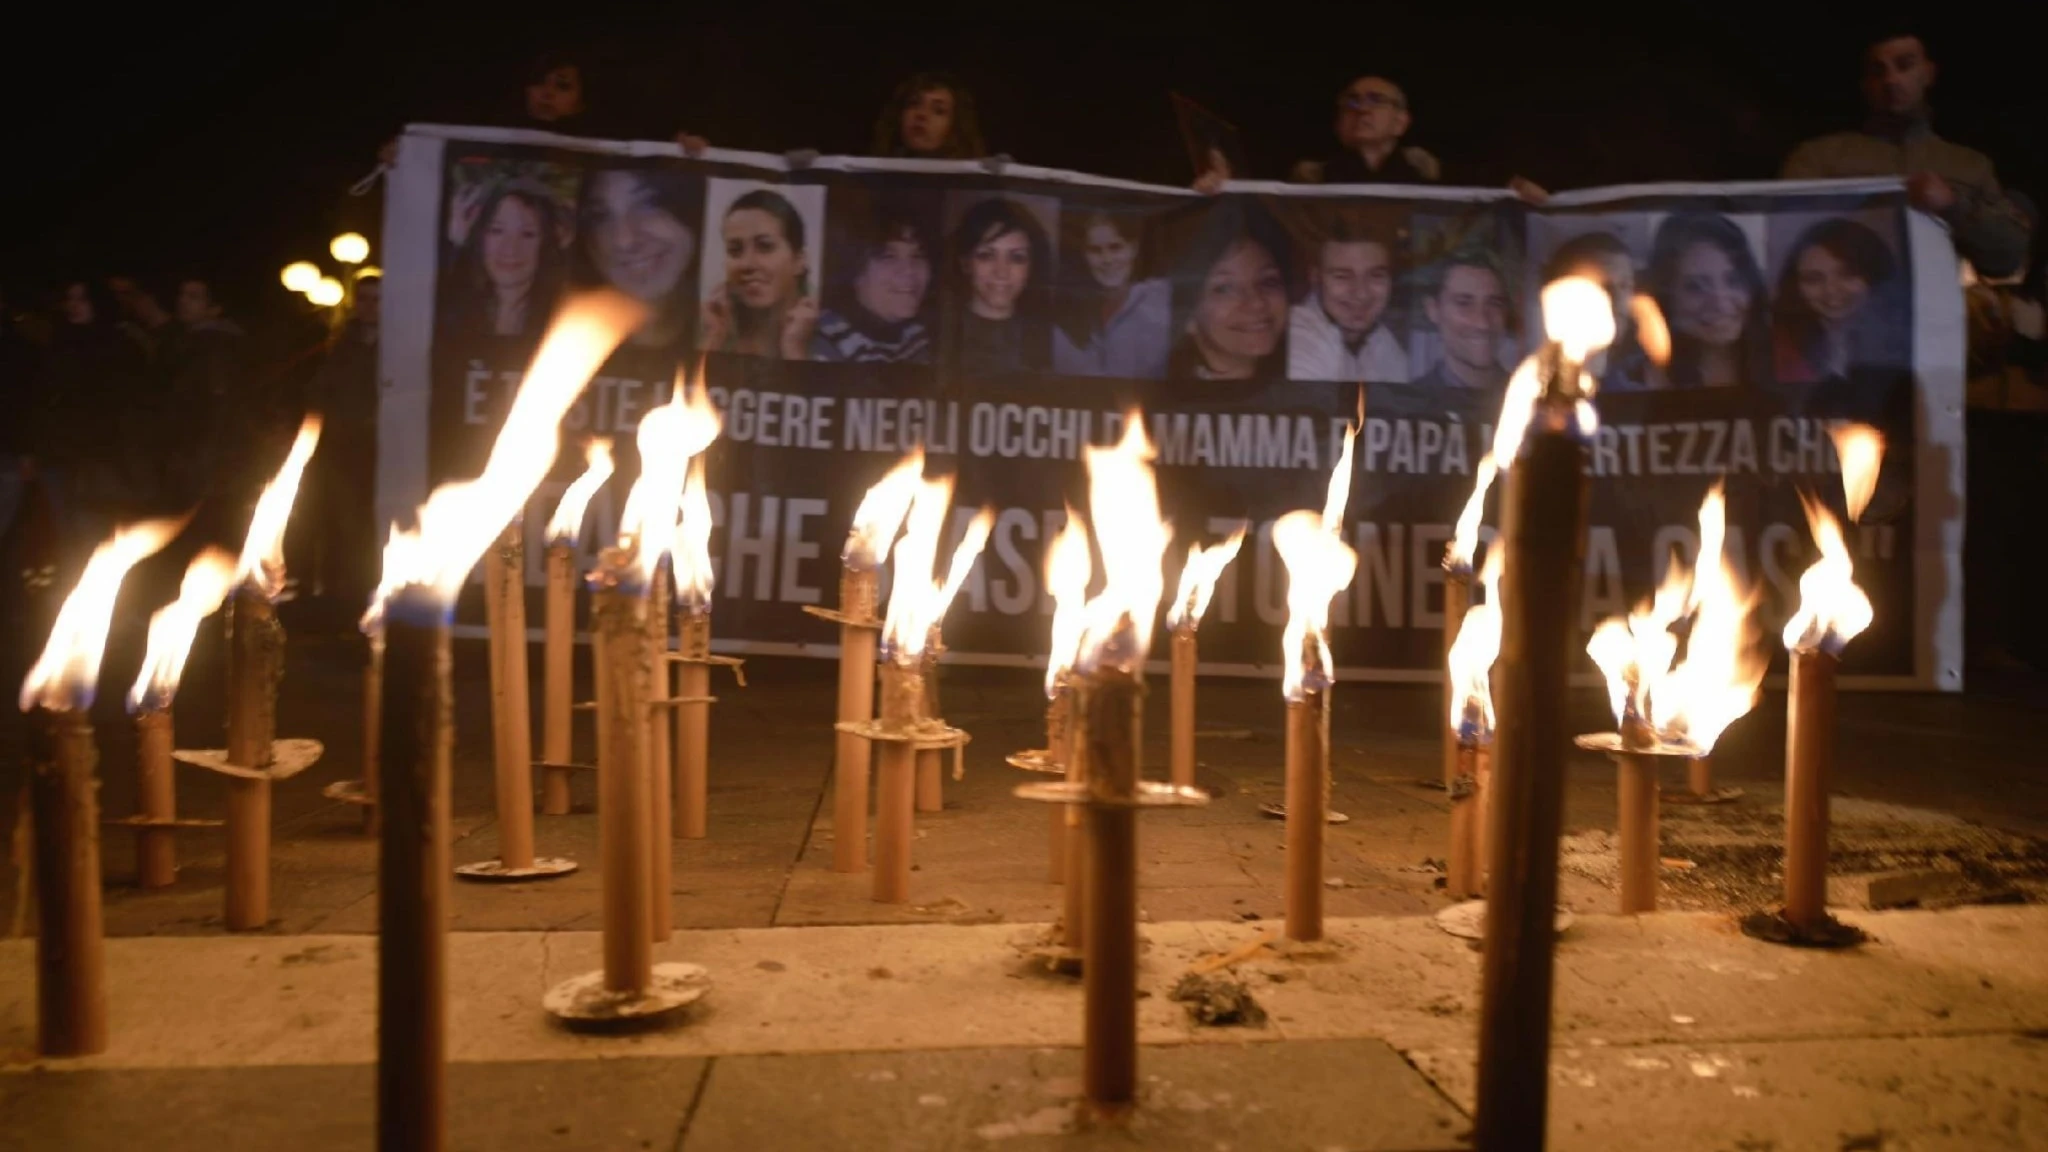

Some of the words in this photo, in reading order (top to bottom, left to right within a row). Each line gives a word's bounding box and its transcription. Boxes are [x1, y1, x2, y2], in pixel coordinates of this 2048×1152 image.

[463, 359, 492, 425] È
[844, 398, 958, 454] NEGLI
[968, 402, 1092, 460] OCCHI
[1151, 411, 1319, 470] MAMMA
[1364, 411, 1469, 476] PAPÀ
